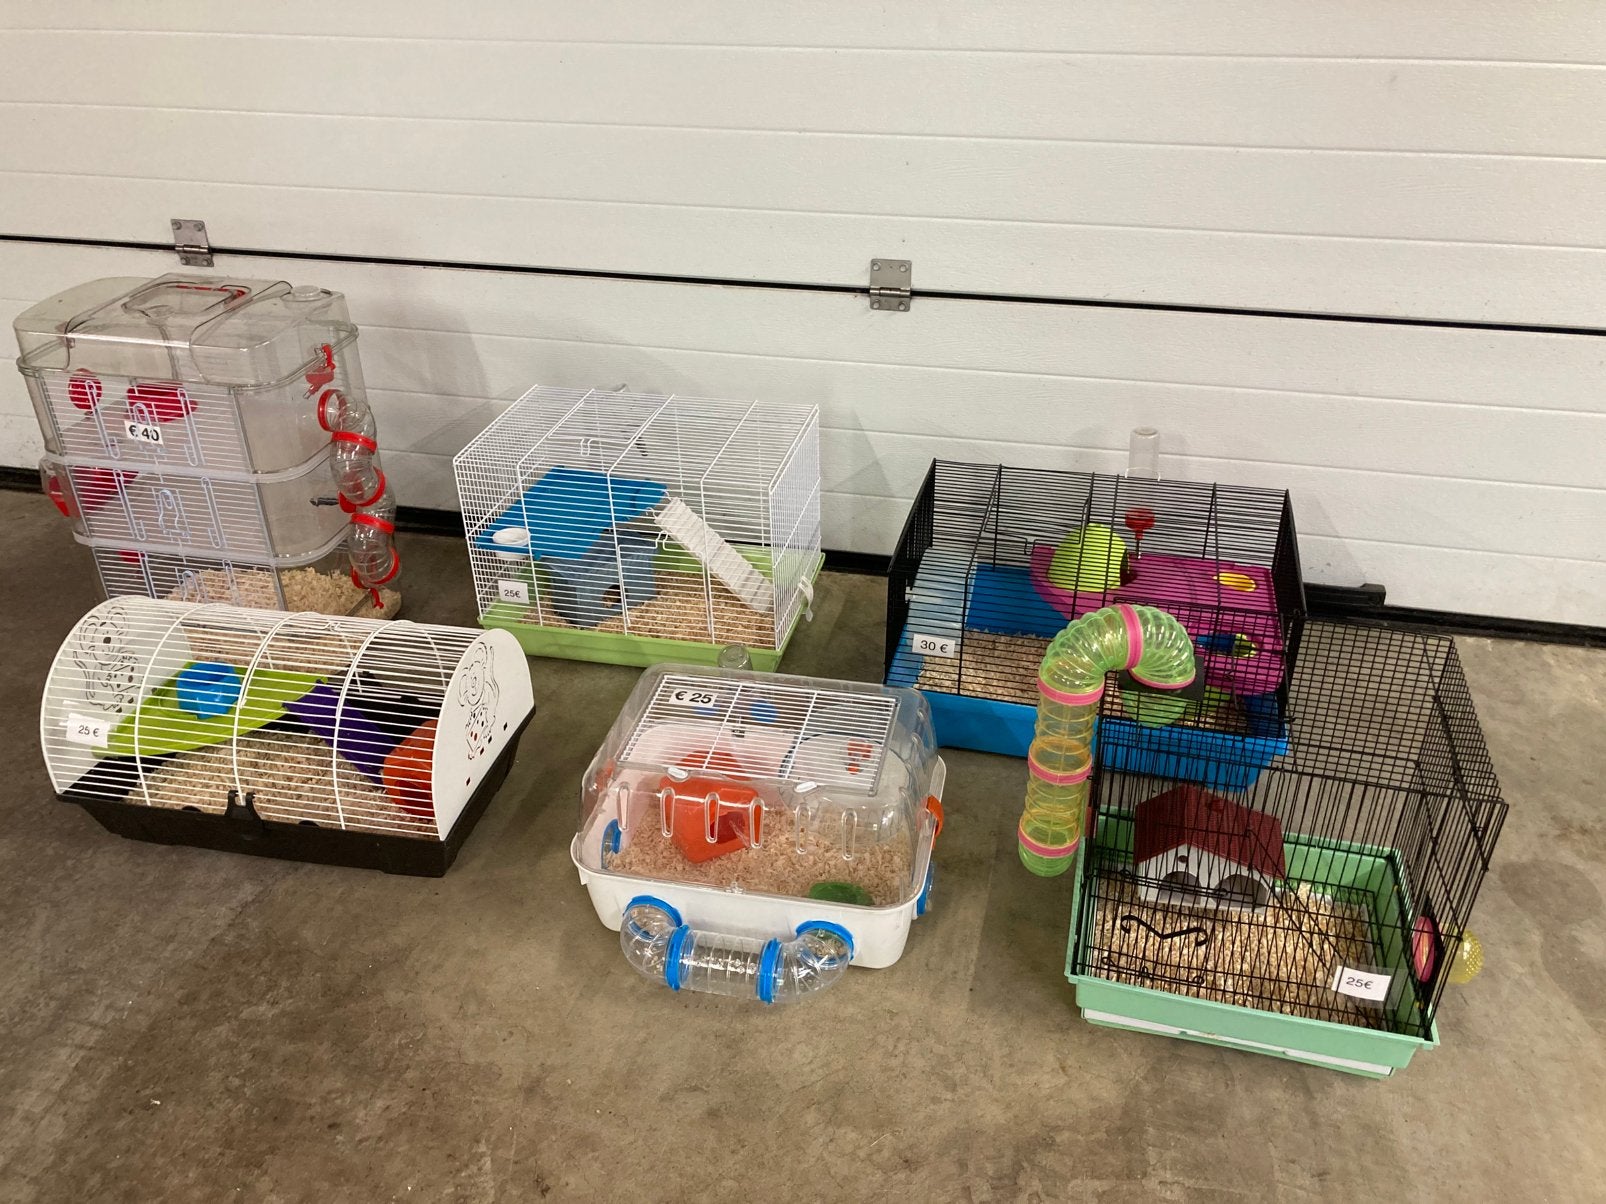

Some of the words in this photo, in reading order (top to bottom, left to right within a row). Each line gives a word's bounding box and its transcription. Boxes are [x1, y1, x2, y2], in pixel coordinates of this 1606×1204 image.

[141, 427, 160, 442] 40
[504, 589, 521, 599] 25€
[920, 640, 936, 651] 30
[940, 643, 949, 654] €
[675, 690, 687, 701] €
[689, 692, 713, 704] 25
[78, 724, 90, 736] 25
[92, 727, 100, 738] €
[1346, 976, 1374, 990] 25€
